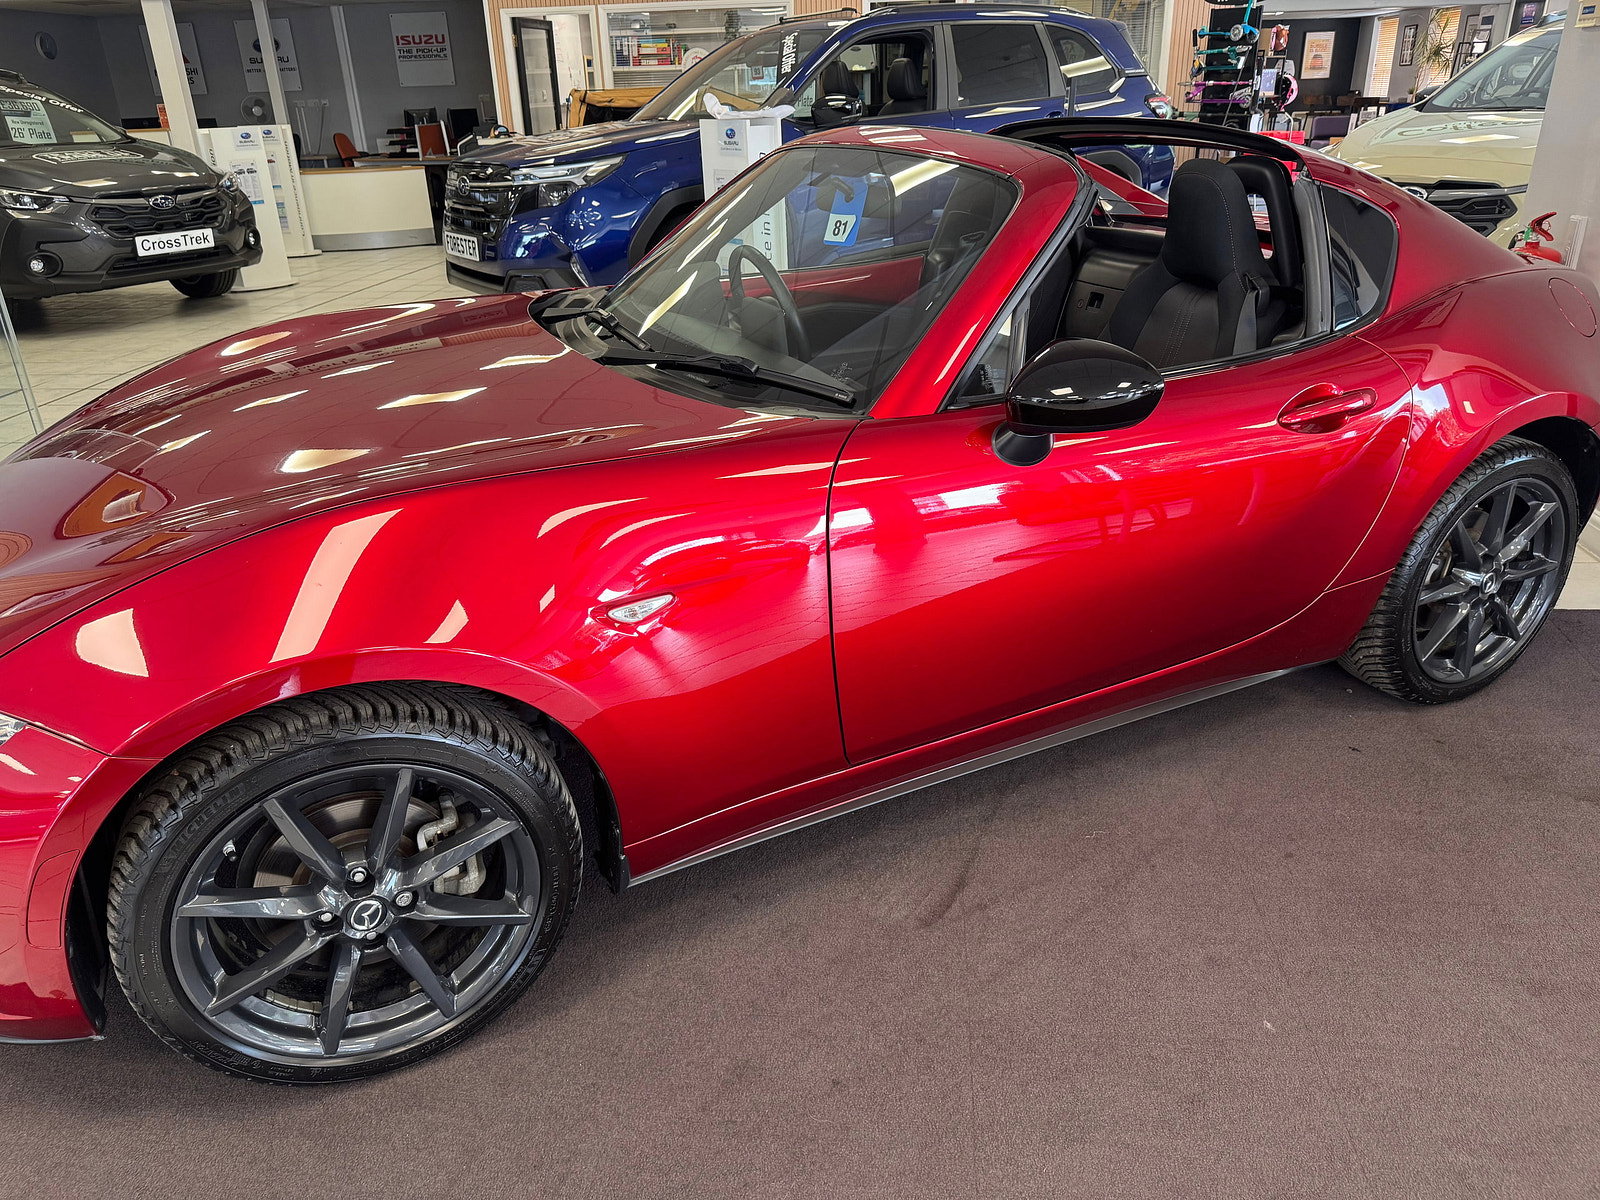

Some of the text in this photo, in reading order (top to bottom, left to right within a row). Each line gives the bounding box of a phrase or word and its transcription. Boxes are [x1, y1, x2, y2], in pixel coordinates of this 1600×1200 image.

[395, 33, 446, 46] ISUZU
[249, 56, 290, 65] SURU
[781, 32, 798, 74] Special Offer
[0, 85, 83, 113] Special Offer
[28, 128, 53, 139] Plate
[832, 219, 849, 237] 81
[141, 232, 211, 251] CrossTrek
[446, 234, 478, 258] FORESTER
